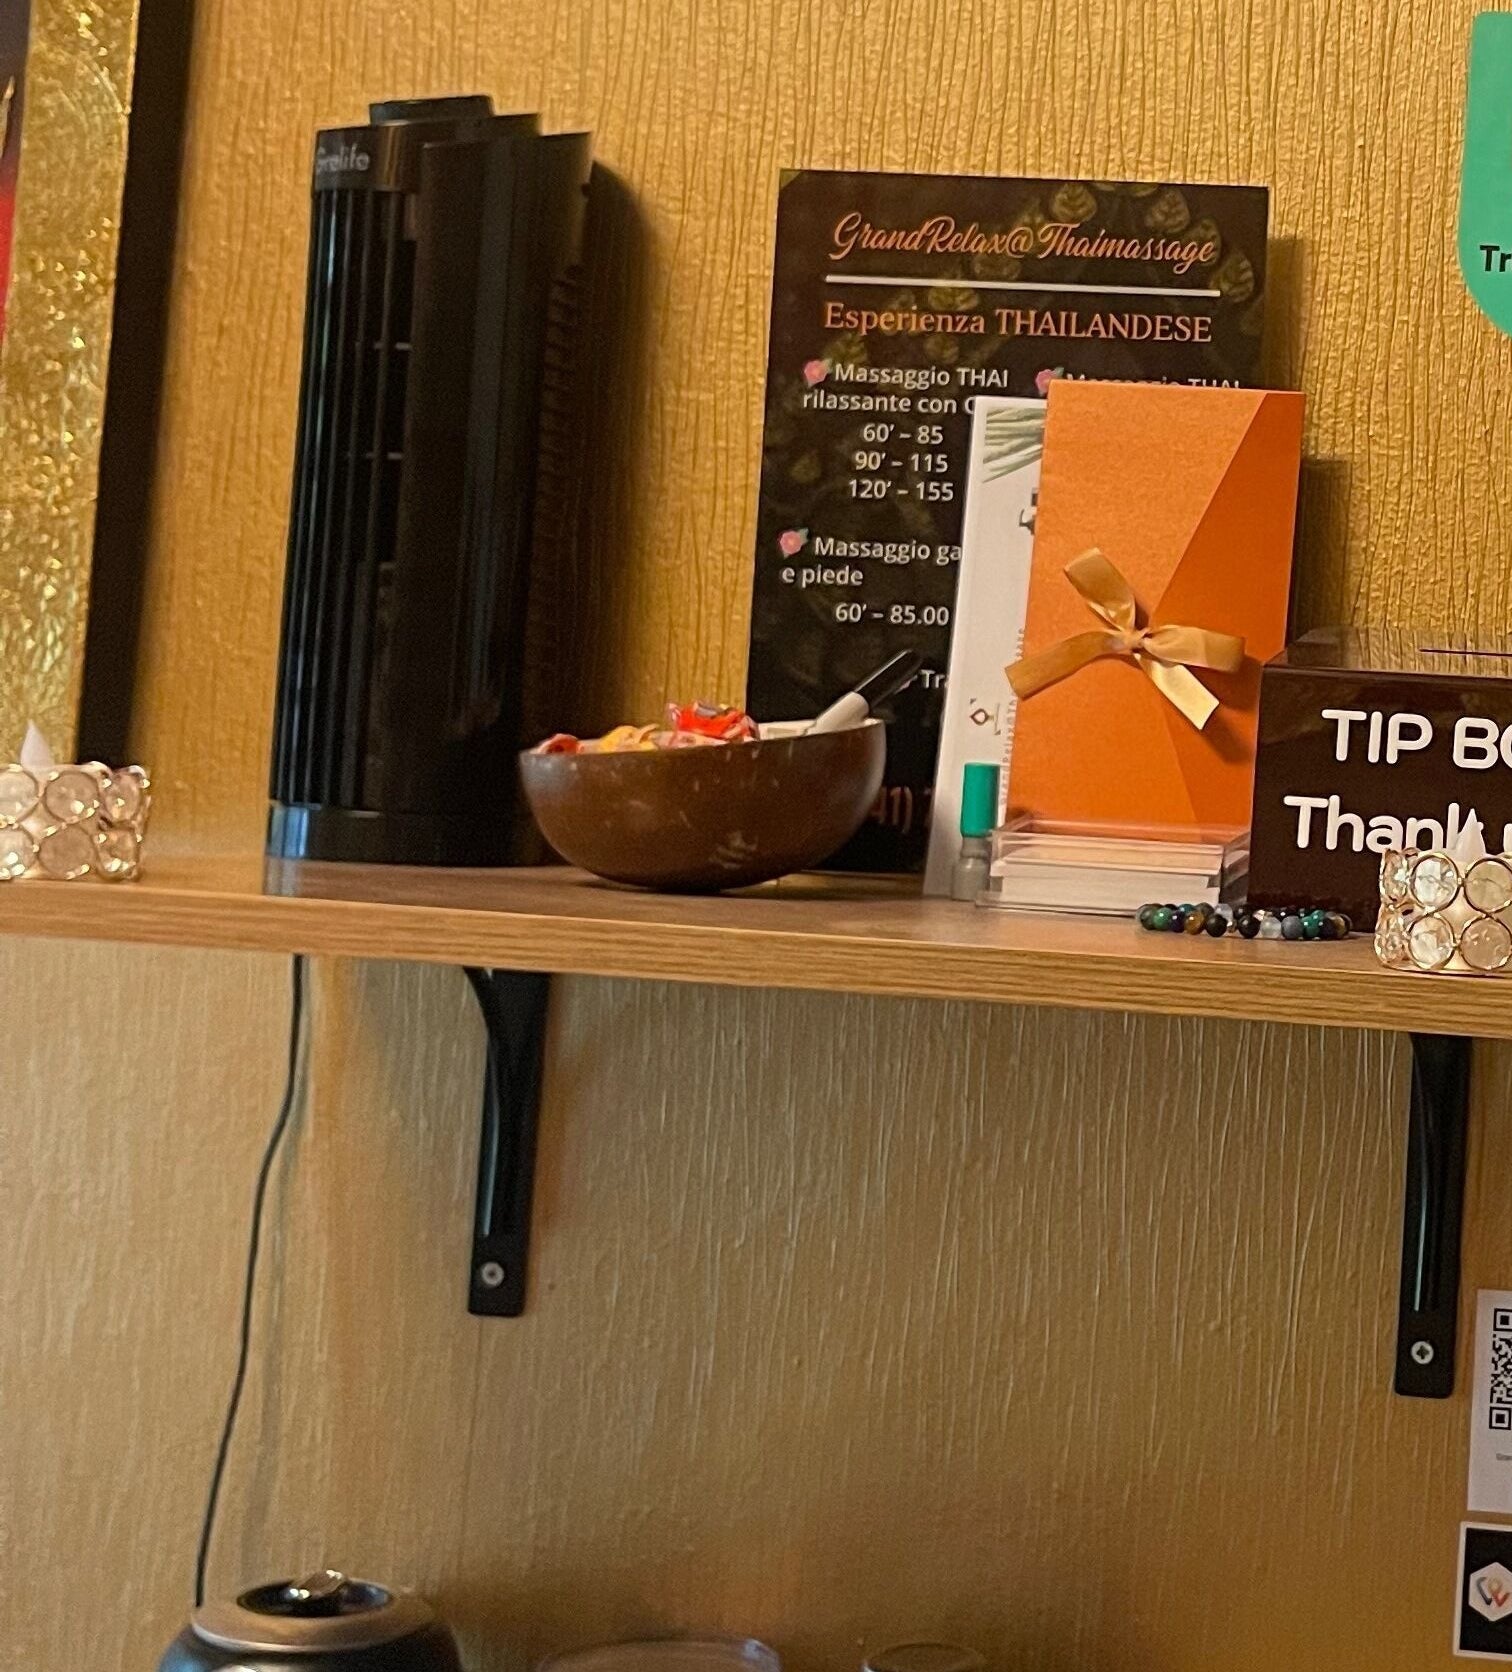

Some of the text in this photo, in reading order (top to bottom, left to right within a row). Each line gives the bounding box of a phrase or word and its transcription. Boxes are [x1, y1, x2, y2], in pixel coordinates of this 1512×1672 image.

[824, 302, 1212, 343] Esperienza THAILANDESE
[835, 364, 1009, 390] Massaggio THAI
[803, 389, 912, 412] rilassante
[918, 398, 957, 414] con
[917, 425, 944, 445] 85
[910, 453, 949, 473] 115
[916, 481, 954, 502] 155
[814, 536, 931, 564] Massaggio
[782, 564, 864, 589] e piede
[890, 605, 950, 626] 85.00
[1321, 708, 1434, 764] TIP
